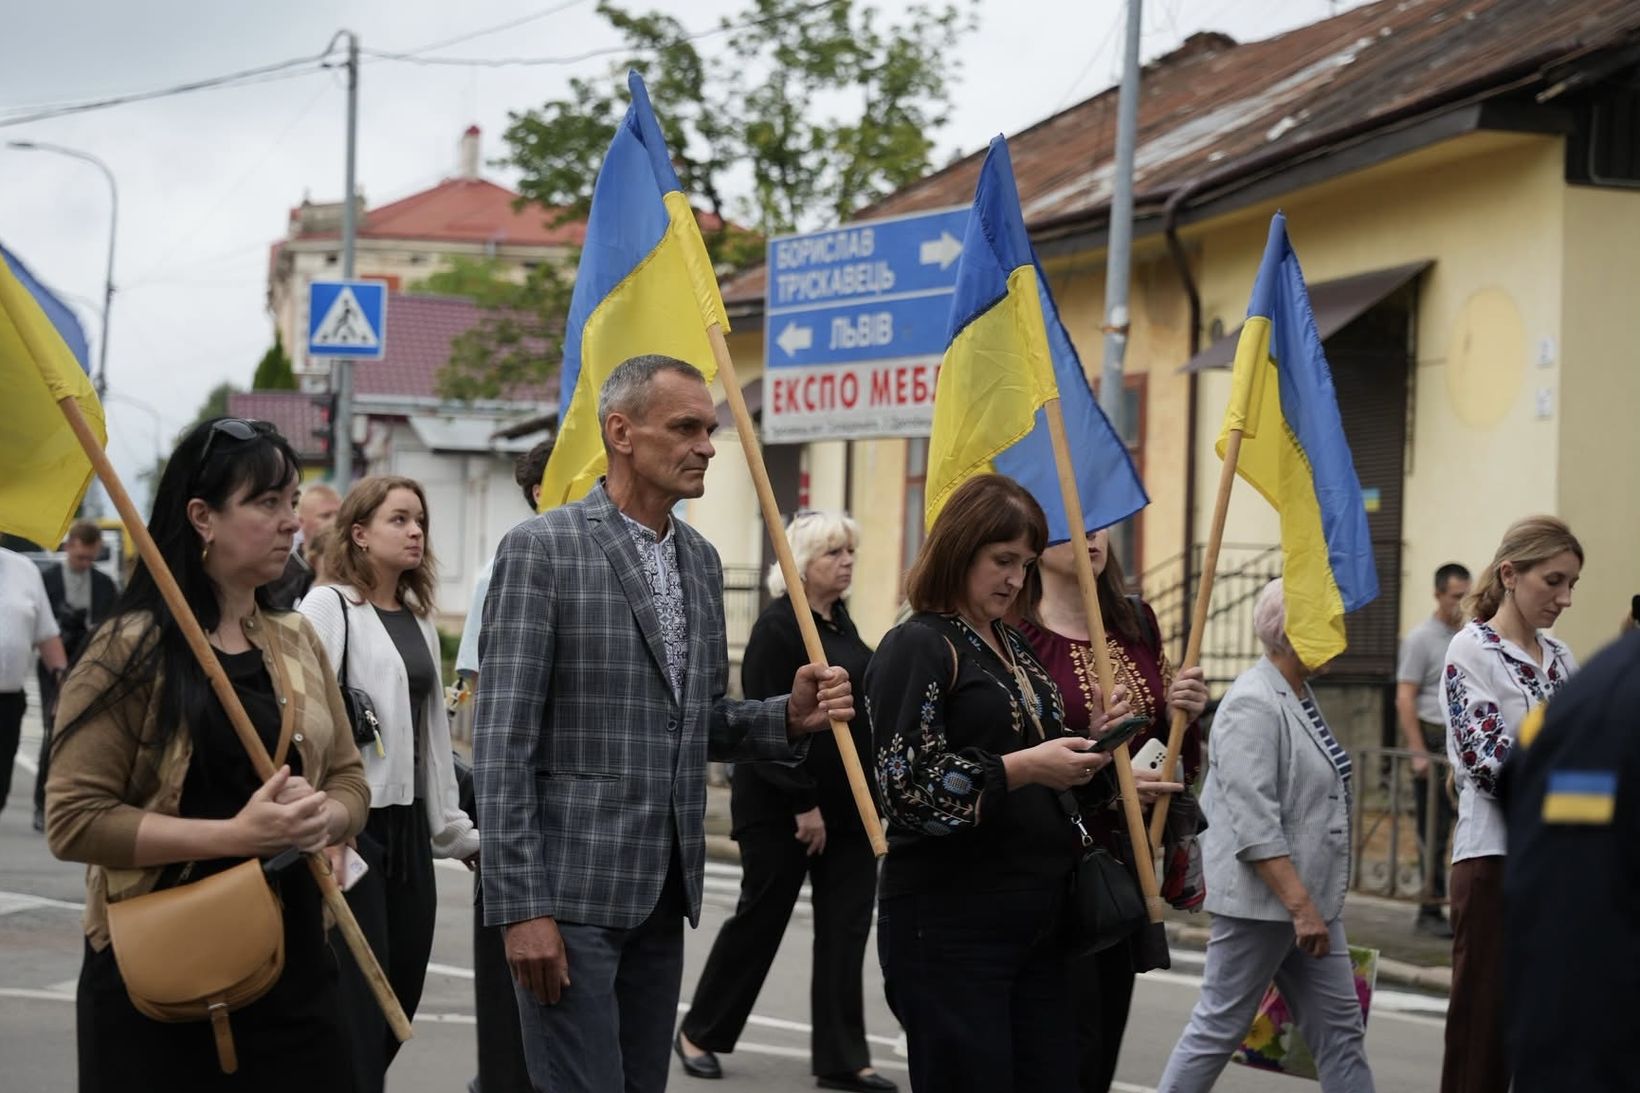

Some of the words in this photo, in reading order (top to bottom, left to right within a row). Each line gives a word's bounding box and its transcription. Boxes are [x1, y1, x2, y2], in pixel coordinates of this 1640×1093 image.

[777, 229, 875, 269] БОРИСЛАВ
[829, 311, 893, 350] ЛЬВІВ
[773, 372, 859, 415] ЕКСПО
